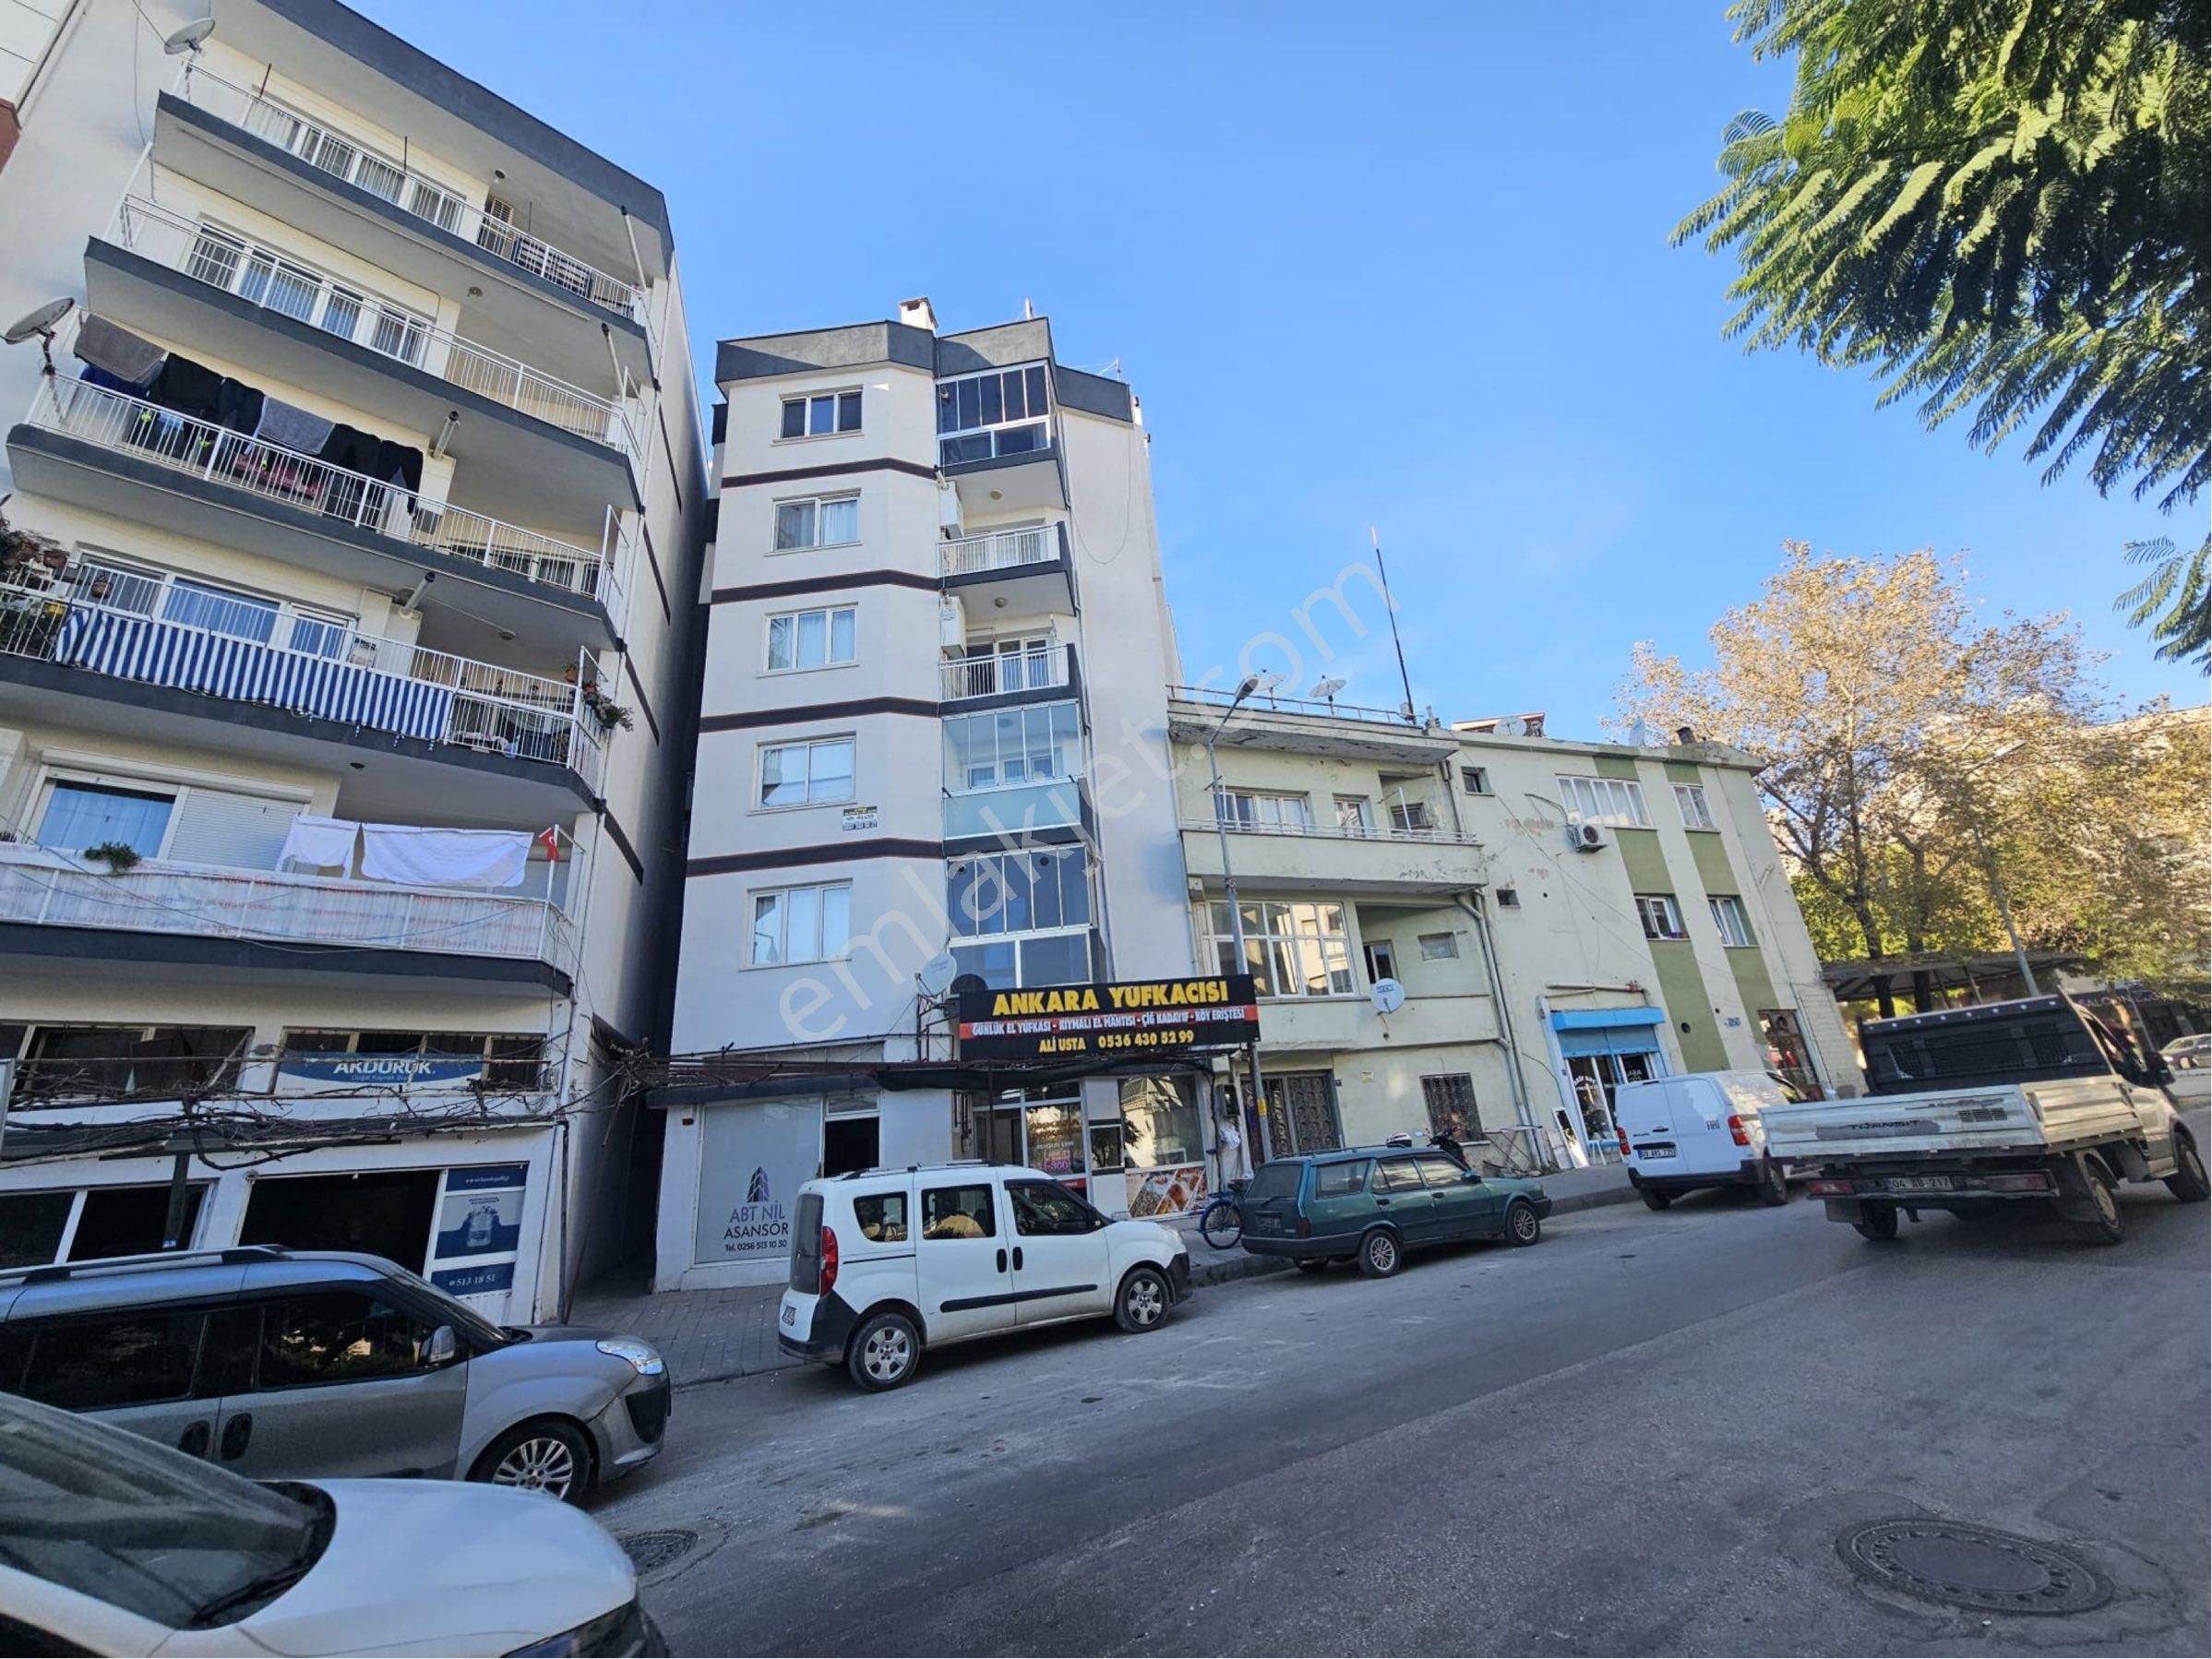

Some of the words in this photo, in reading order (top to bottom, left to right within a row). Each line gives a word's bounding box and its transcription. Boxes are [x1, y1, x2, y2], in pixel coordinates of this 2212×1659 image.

[992, 988, 1100, 1016] ANKARA
[1108, 980, 1228, 1009] YUFKACISI
[1007, 1022, 1016, 1034] EL
[1059, 1017, 1091, 1031] KIYMALI
[1094, 1016, 1103, 1029] EL
[1104, 1014, 1136, 1028] MANTISI
[1156, 1011, 1189, 1024] KADAYIF
[1195, 1009, 1210, 1022] KÖY
[1039, 1035, 1057, 1053] ALİ
[1058, 1036, 1086, 1052] USTA
[1098, 1033, 1131, 1049] 0536
[1134, 1032, 1157, 1046] 430
[1161, 1031, 1177, 1044] 52
[1178, 1030, 1194, 1044] 99
[729, 1205, 759, 1223] ABT
[762, 1200, 785, 1220] NİL
[723, 1220, 789, 1240] ASANSÖR
[737, 1242, 755, 1251] 0256
[757, 1240, 768, 1249] 513
[770, 1240, 777, 1248] 10
[456, 1276, 472, 1286] 513
[473, 1275, 484, 1284] 18
[486, 1274, 496, 1283] 51
